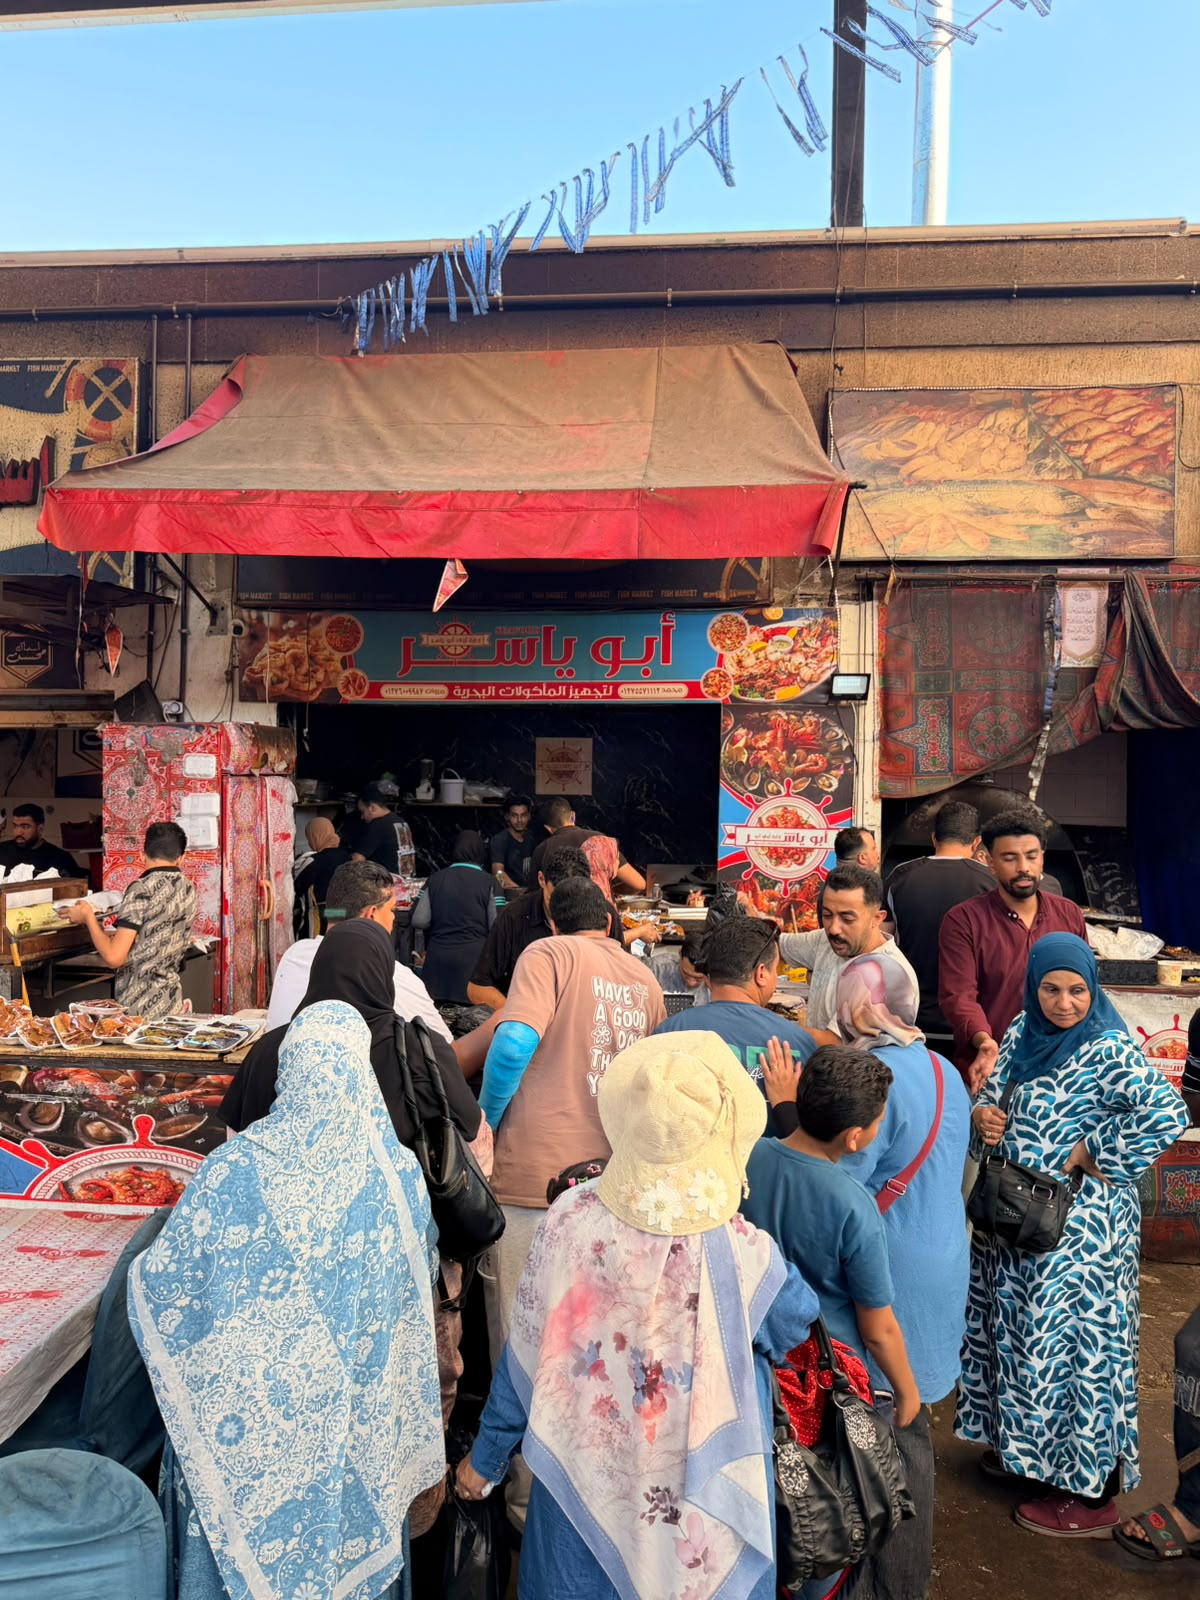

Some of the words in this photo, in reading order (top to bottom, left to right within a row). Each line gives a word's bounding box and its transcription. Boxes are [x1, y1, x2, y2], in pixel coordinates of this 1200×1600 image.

[397, 625, 578, 678] ياسر
[590, 612, 676, 678] أبو
[453, 685, 496, 699] البحرية
[569, 684, 613, 699] لتجهيز
[745, 833, 806, 846] ياسر
[810, 831, 828, 846] أبو
[593, 976, 633, 1007] HAVE
[595, 1002, 606, 1022] A
[613, 1006, 646, 1030] GOOD
